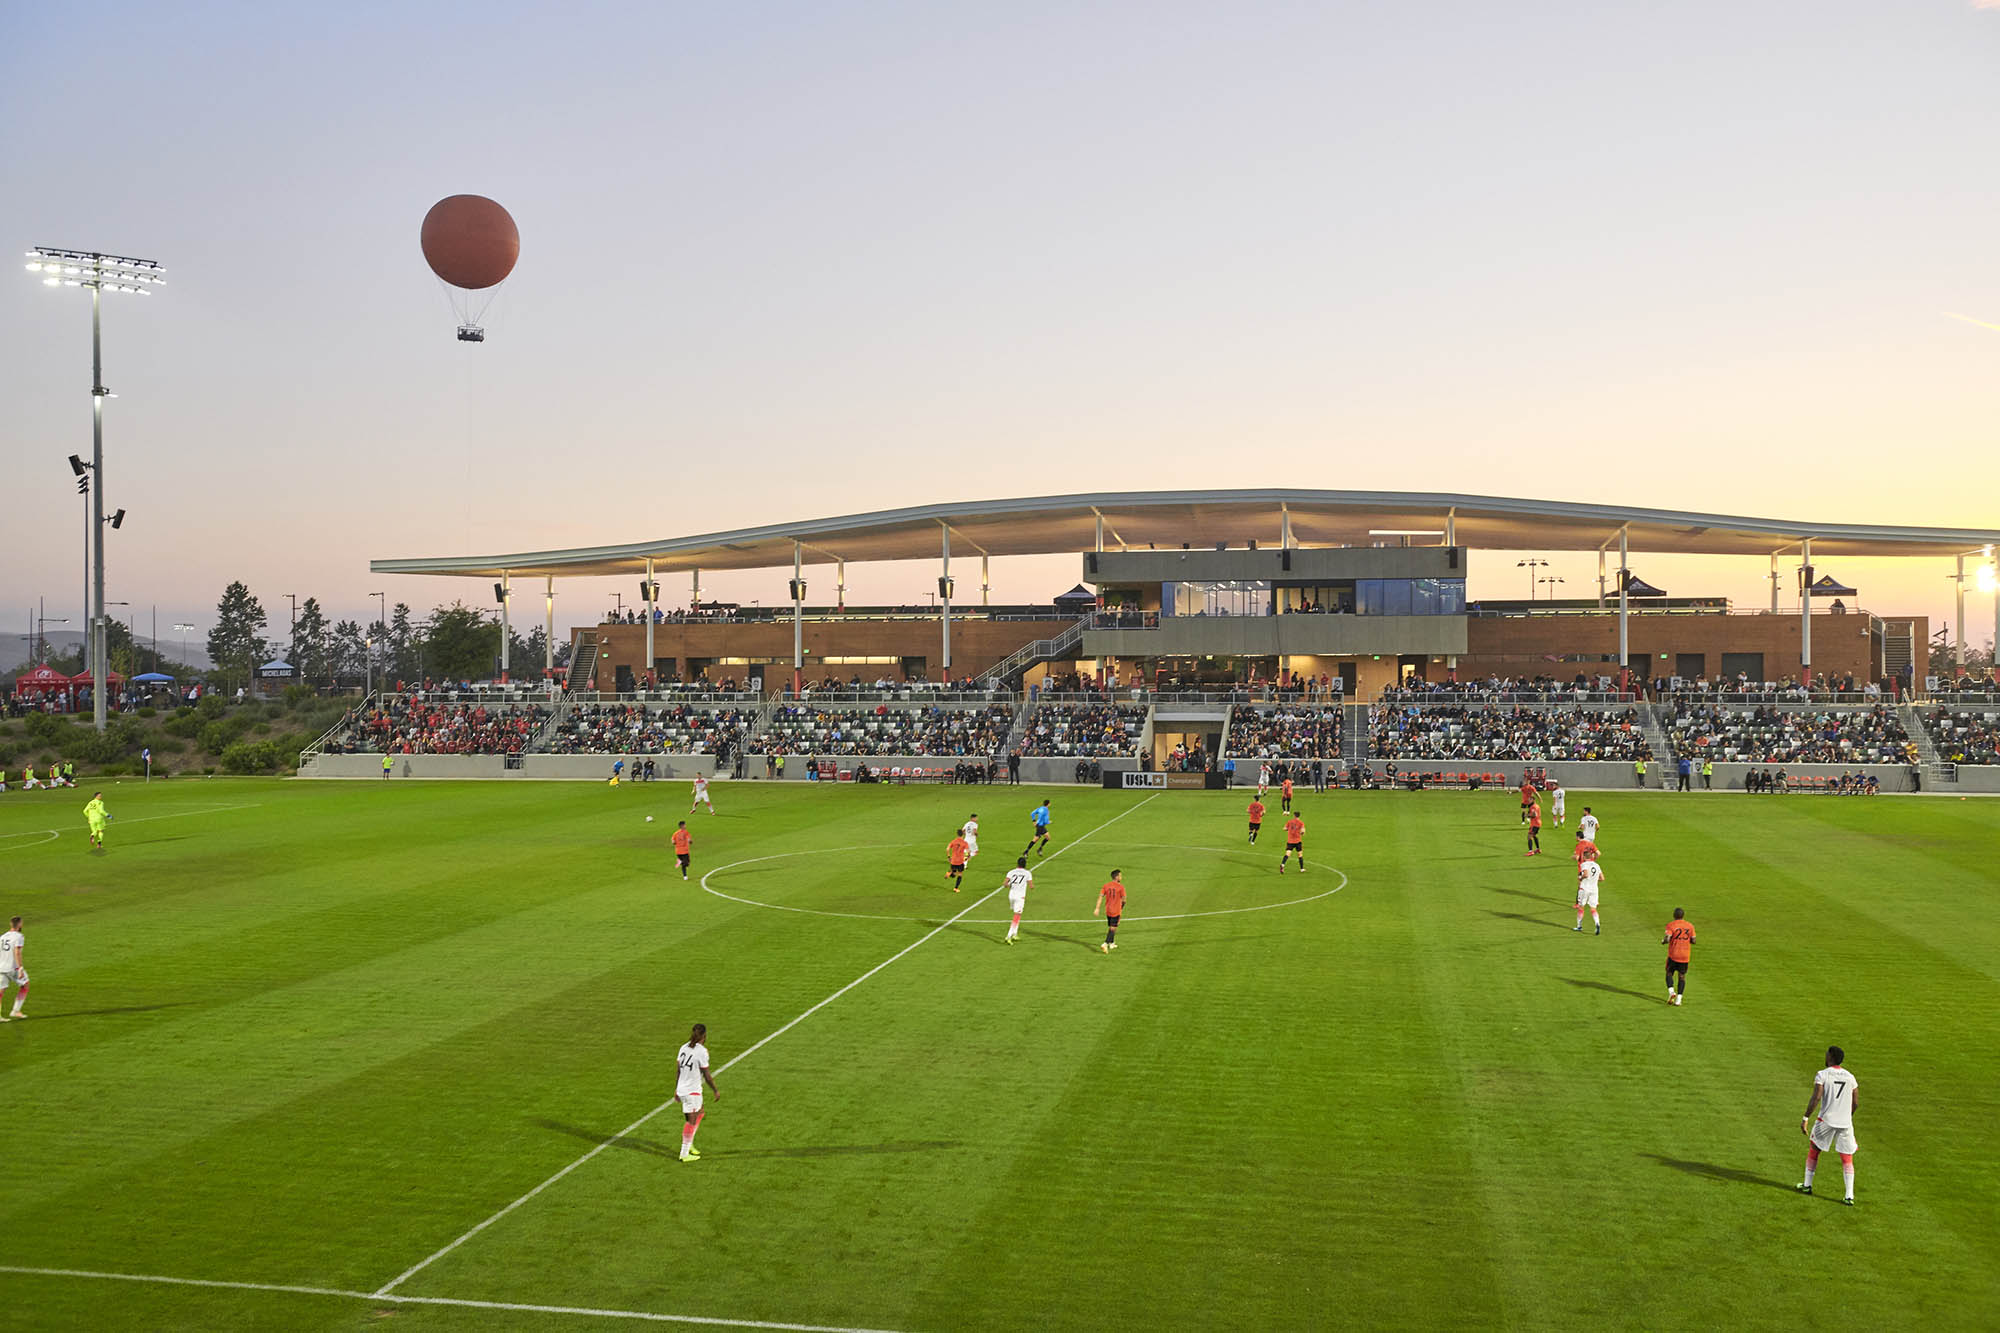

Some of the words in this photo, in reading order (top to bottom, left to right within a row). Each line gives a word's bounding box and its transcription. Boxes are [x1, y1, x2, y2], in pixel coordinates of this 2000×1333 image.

[1591, 867, 1596, 876] 9
[1010, 874, 1025, 885] 27
[1675, 928, 1690, 940] 23
[1, 939, 11, 951] 15
[680, 1052, 694, 1071] 24
[1833, 1081, 1846, 1099] 7
